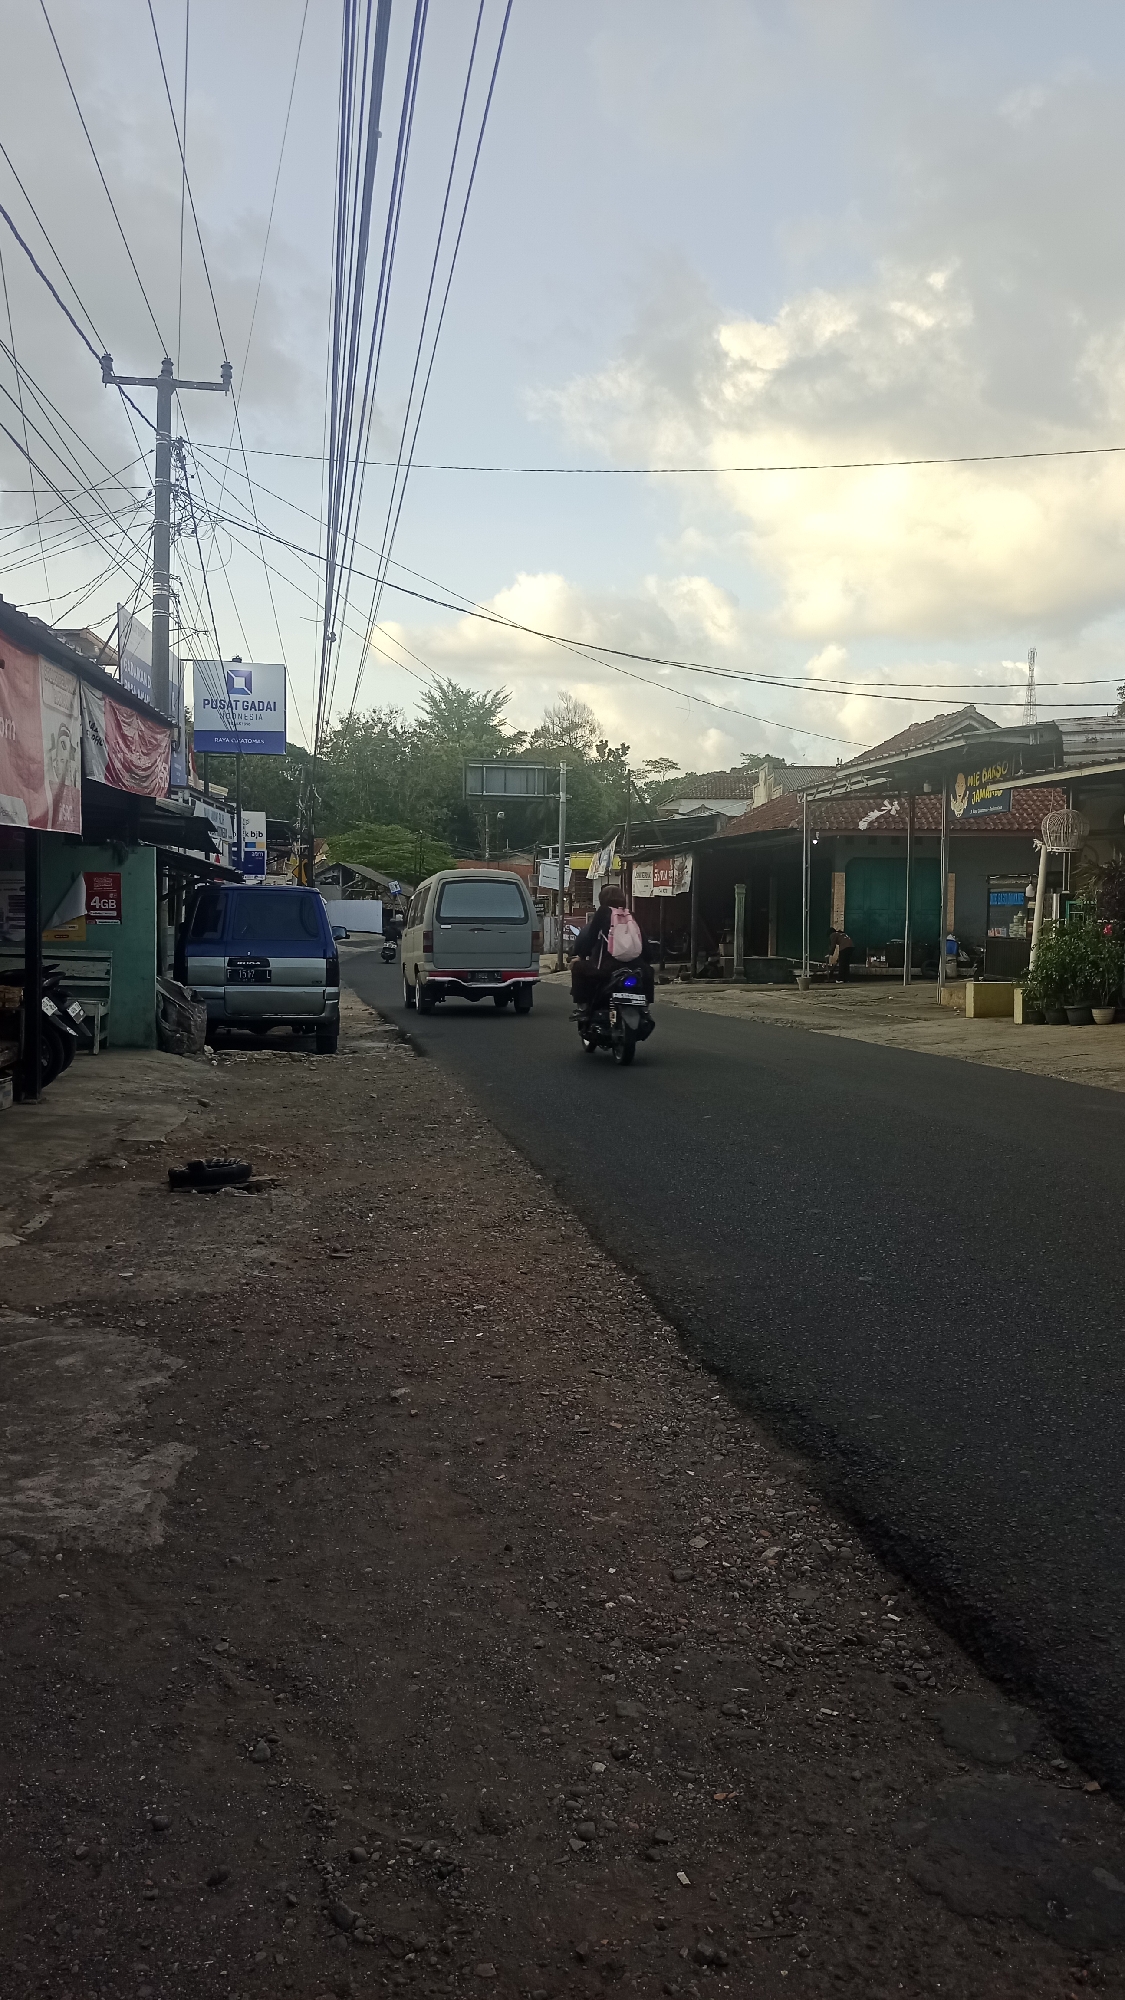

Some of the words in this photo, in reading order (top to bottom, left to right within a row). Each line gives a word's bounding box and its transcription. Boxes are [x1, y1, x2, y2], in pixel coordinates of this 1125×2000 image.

[203, 699, 240, 710] PUSAT
[242, 701, 277, 711] GADAI
[217, 712, 263, 721] NDONESIA
[250, 831, 264, 839] bjb
[91, 896, 117, 909] 4GB
